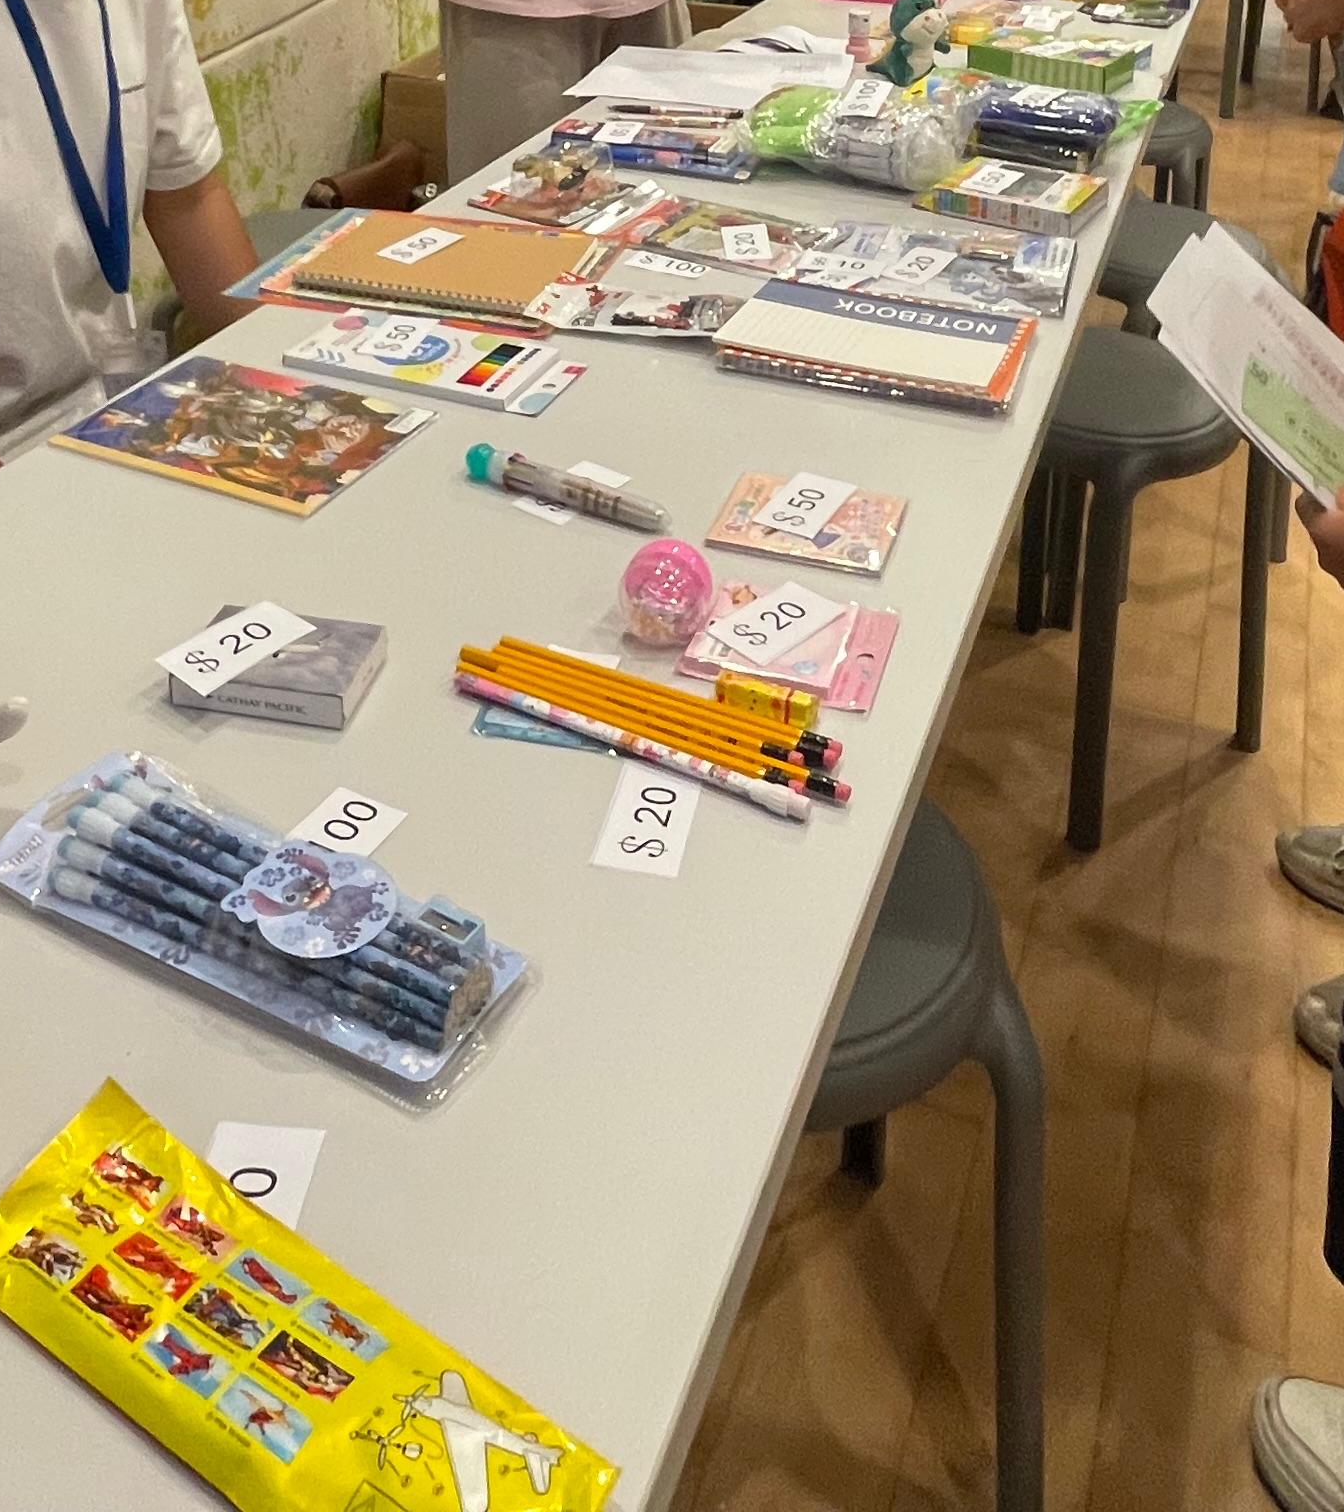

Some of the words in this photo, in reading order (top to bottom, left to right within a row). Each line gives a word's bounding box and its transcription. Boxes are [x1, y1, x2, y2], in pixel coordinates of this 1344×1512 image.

[833, 297, 998, 336] NOTEBOOK
[217, 694, 261, 709] CATHAY
[263, 700, 307, 715] PACIFIC
